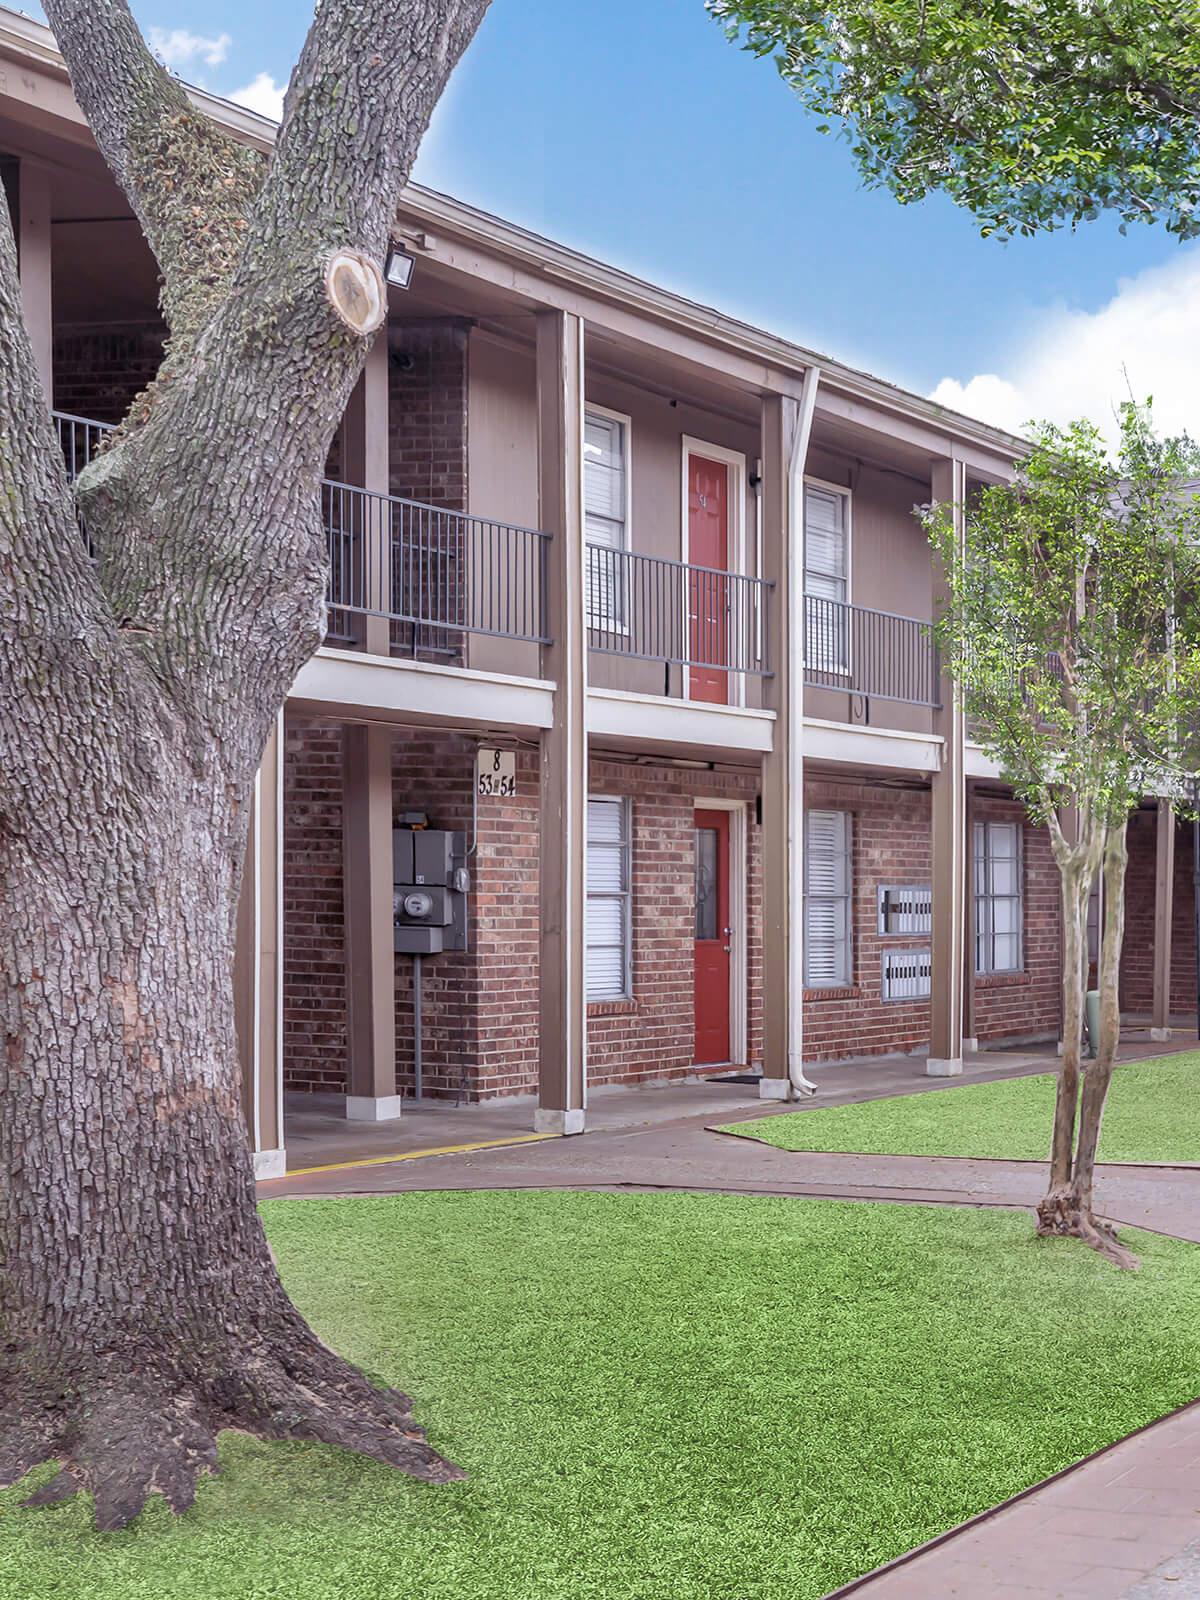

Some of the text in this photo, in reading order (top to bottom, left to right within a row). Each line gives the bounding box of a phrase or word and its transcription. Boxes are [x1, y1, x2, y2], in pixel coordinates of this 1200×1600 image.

[493, 749, 501, 771] 8
[479, 774, 493, 794] 53
[500, 775, 515, 796] 54
